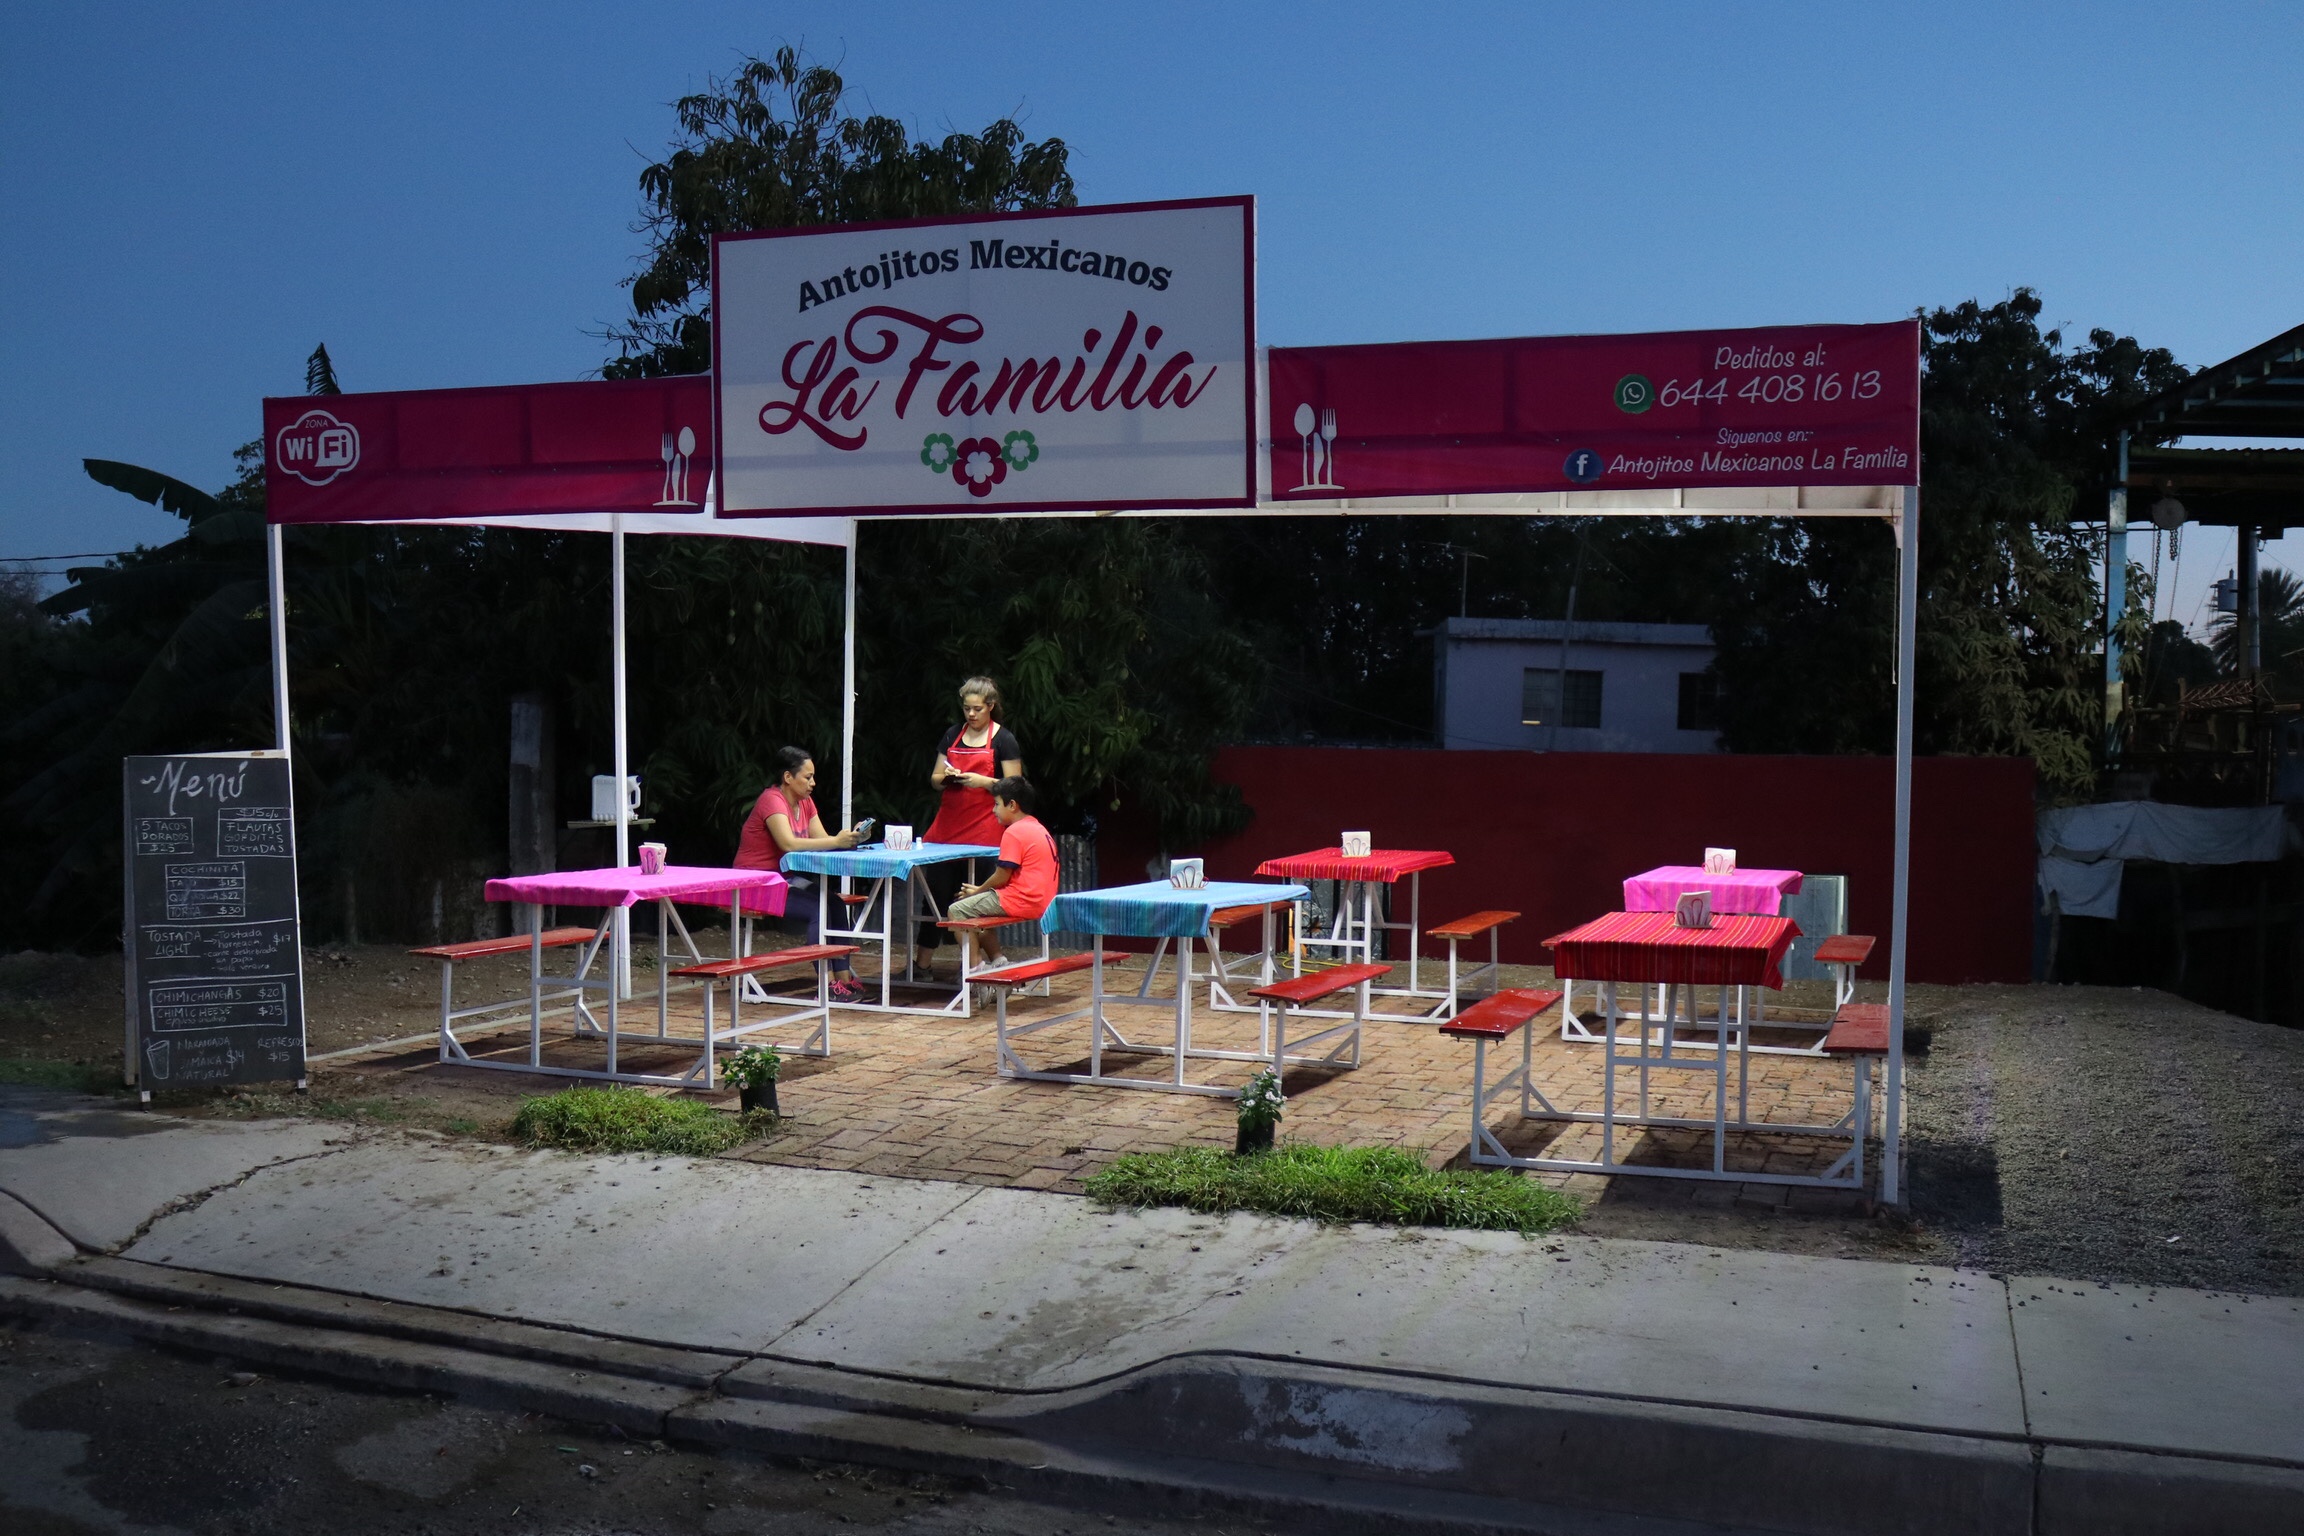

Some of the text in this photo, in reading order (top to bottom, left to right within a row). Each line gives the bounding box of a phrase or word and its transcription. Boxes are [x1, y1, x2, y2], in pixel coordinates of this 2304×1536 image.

[799, 239, 1172, 313] Antojitos Mexicanos
[1714, 342, 1826, 370] Pedidos al:
[759, 305, 1218, 451] La Familia
[1659, 370, 1882, 407] 644 408 16 13
[305, 419, 329, 429] ZONA
[1607, 446, 1909, 480] Antojitos Mexicanos La Familia
[141, 820, 187, 832] 5 TACOS
[226, 822, 283, 834] FLAUTAS
[142, 832, 189, 841] DORADOS
[150, 843, 176, 852] $25
[225, 844, 285, 854] TOSTADAS
[171, 864, 239, 874] COCHINITA
[218, 879, 238, 887] $15
[219, 891, 241, 900] $22
[170, 905, 241, 917] TORTA $30
[146, 929, 201, 942] TOSTADA
[273, 932, 291, 946] $17
[155, 943, 191, 957] LIGHT
[156, 987, 280, 1004] CHIMICHANGAS $20
[257, 1005, 284, 1016] $25
[268, 1050, 290, 1062] $15
